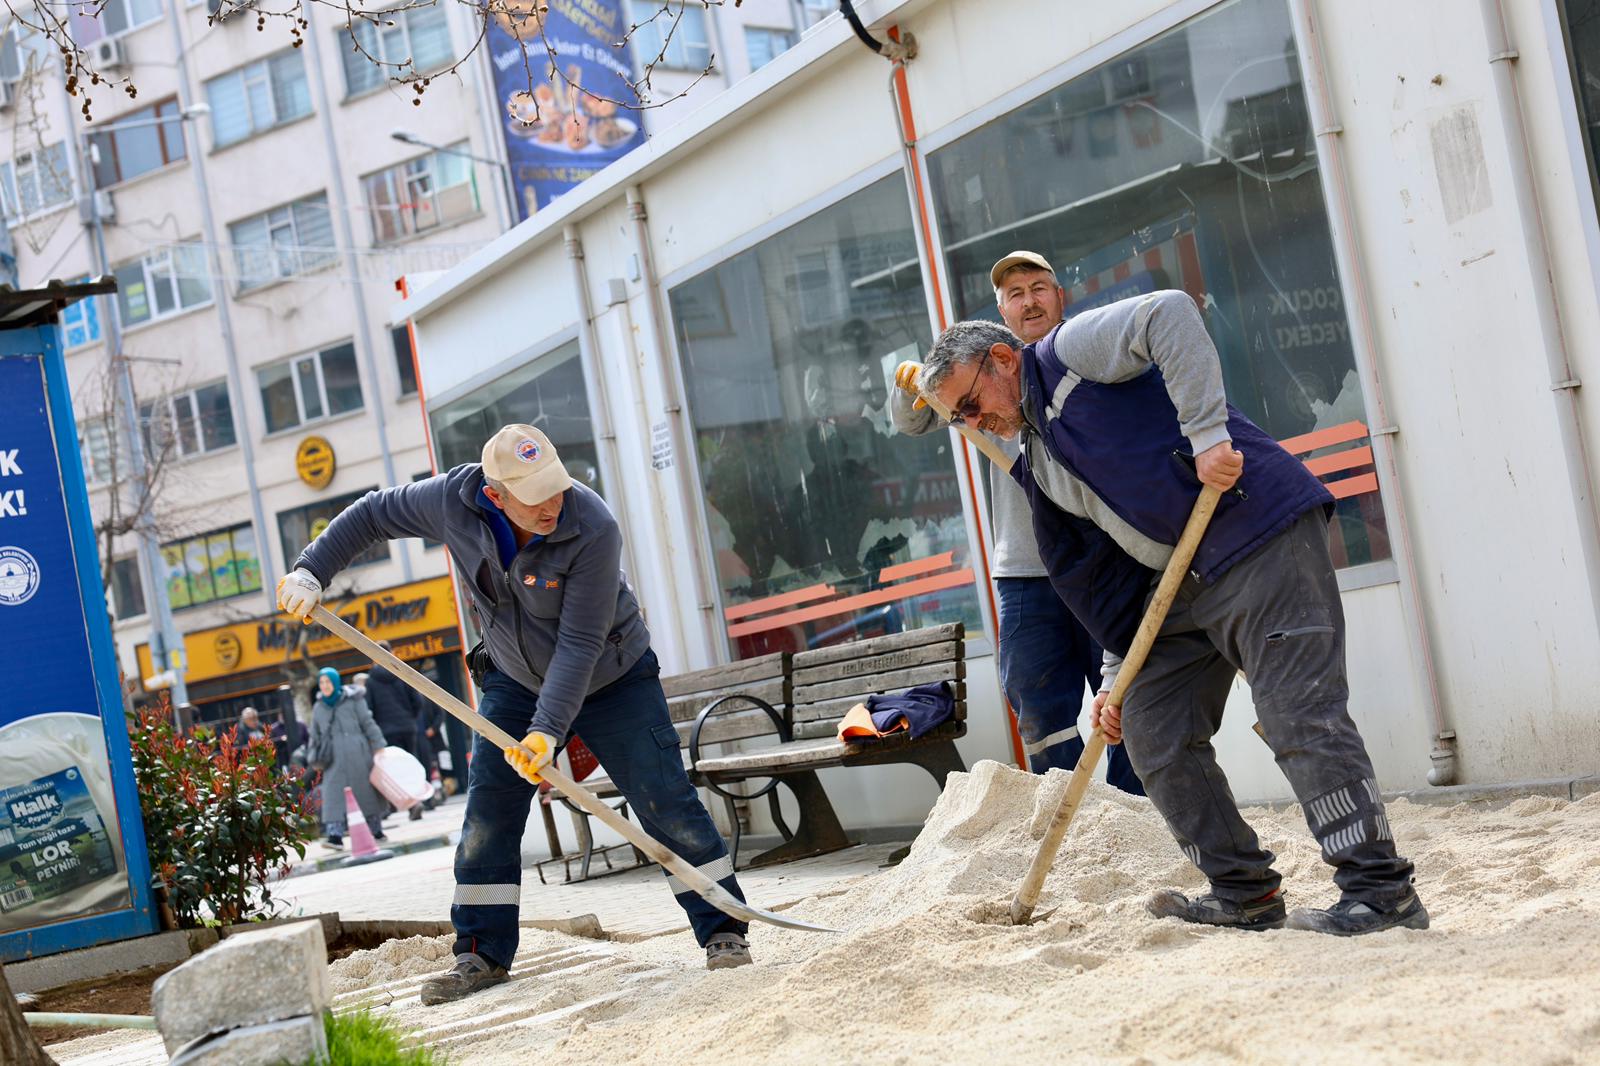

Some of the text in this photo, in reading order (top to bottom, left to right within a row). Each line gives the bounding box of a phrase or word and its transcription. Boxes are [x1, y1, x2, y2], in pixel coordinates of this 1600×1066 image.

[366, 595, 430, 630] Döner
[11, 793, 58, 818] Halk
[17, 838, 37, 852] Tam
[56, 824, 77, 837] taze
[31, 840, 73, 867] LOR
[36, 854, 81, 882] PEYNİRİ
